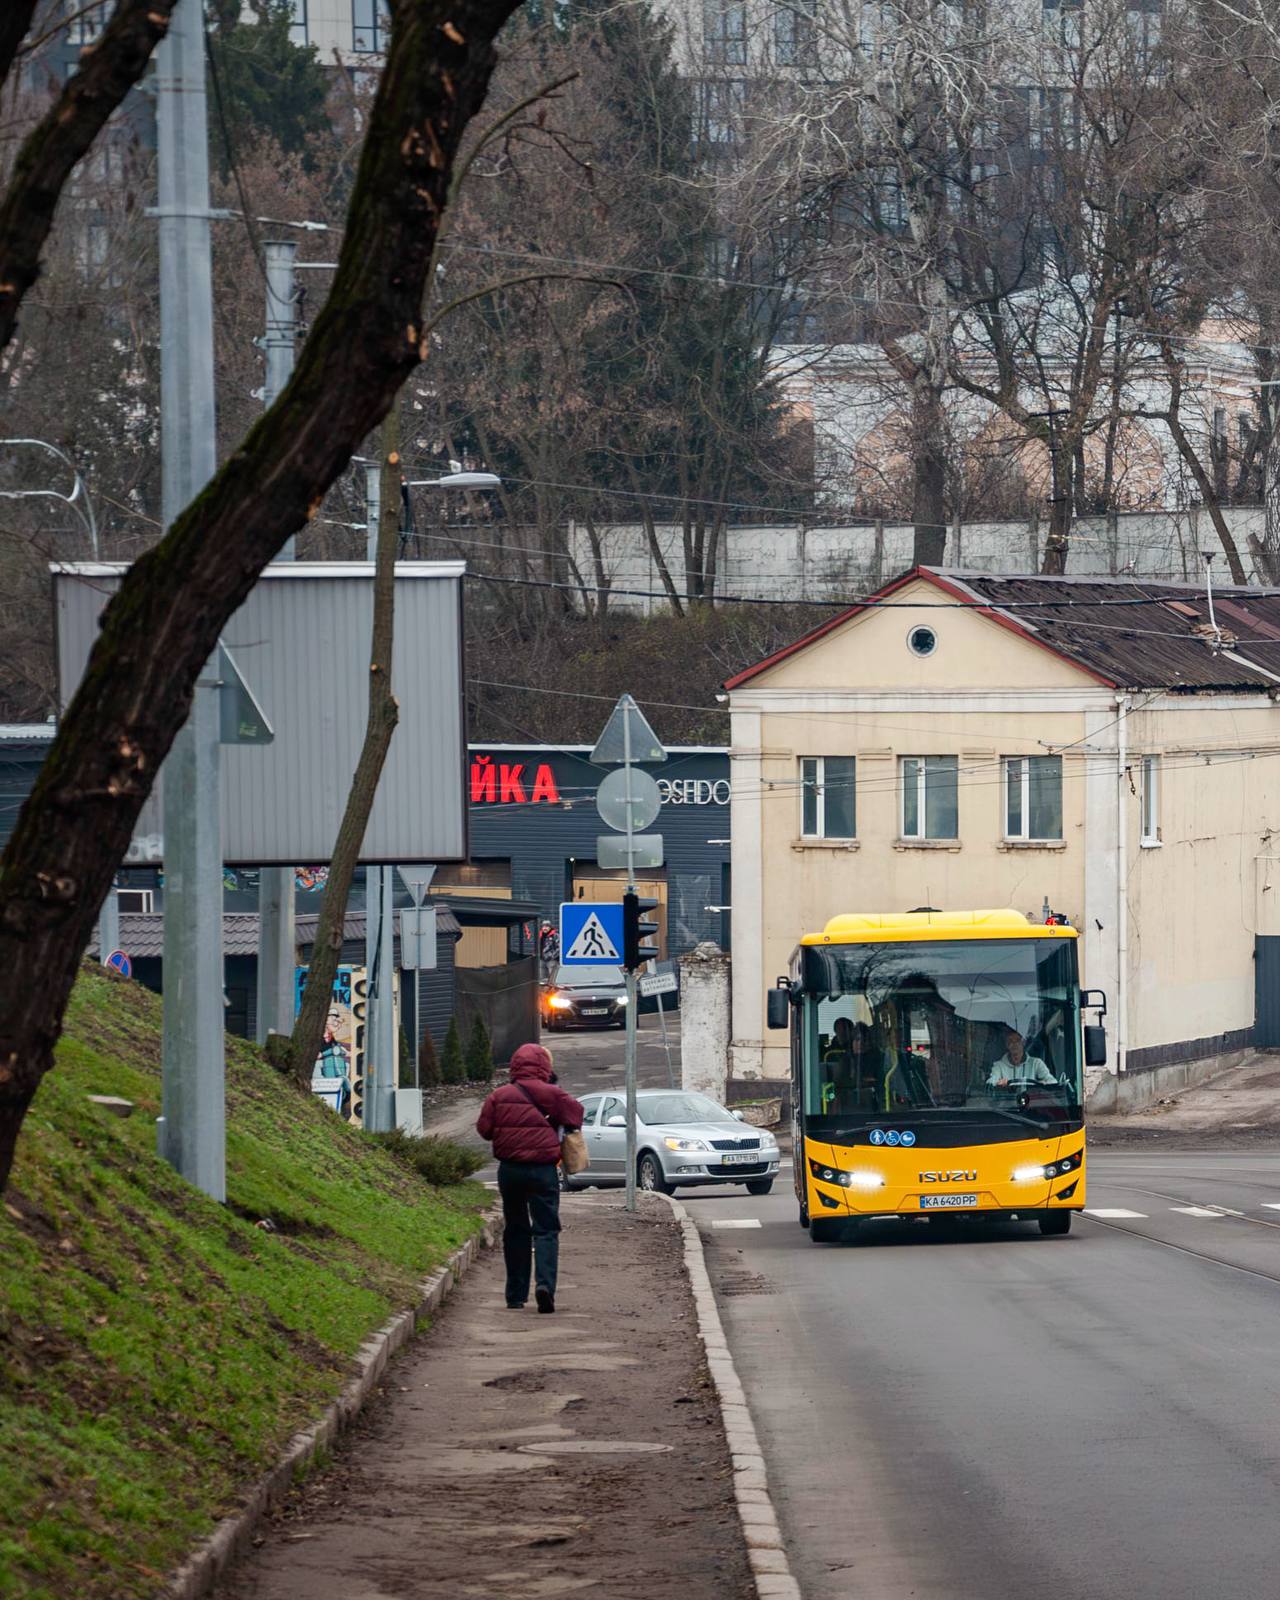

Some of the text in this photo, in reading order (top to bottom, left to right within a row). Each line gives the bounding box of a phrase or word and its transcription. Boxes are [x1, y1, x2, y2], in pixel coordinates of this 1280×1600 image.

[919, 1169, 977, 1183] ISUZU
[925, 1195, 976, 1207] KA 6420 PP
